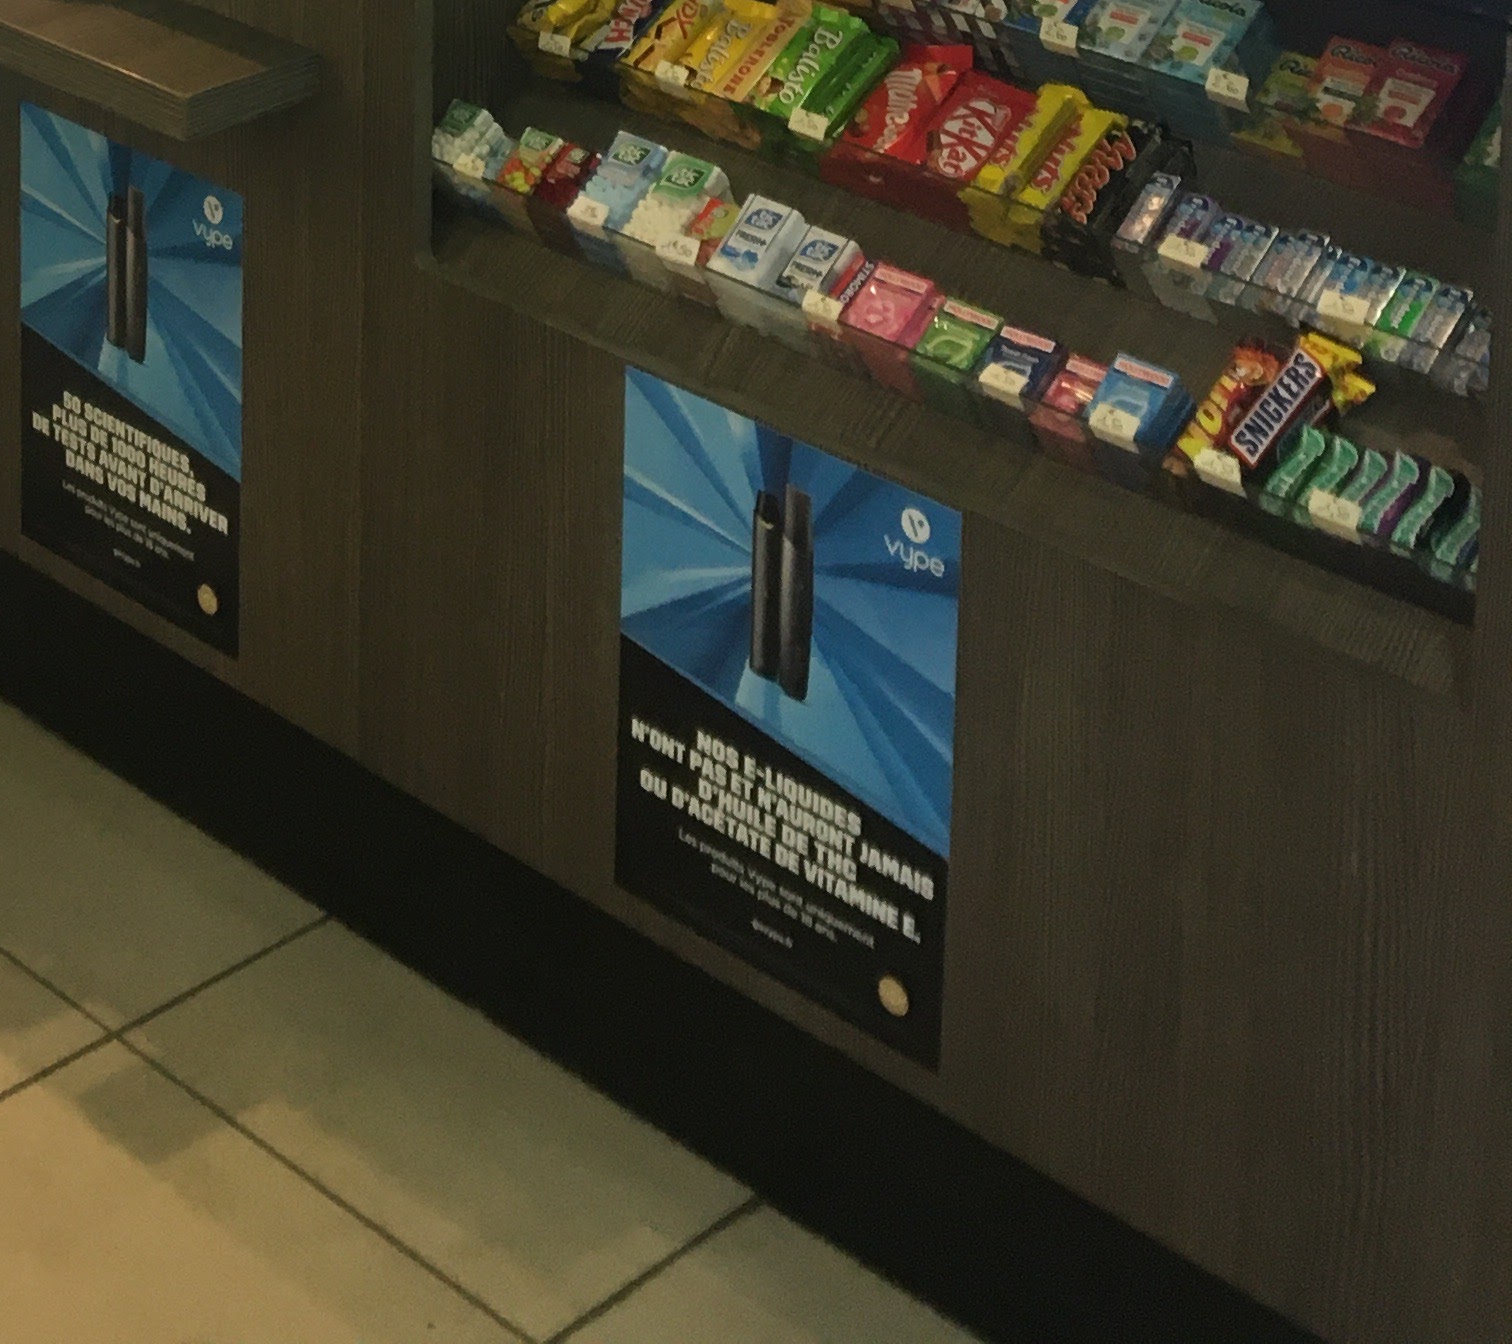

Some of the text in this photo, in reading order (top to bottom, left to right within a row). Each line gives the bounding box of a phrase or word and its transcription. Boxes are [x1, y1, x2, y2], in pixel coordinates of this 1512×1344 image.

[690, 18, 752, 90] Balisto
[722, 16, 798, 97] TOBLERONE
[779, 25, 844, 105] Balisto
[1391, 45, 1461, 75] Ricola
[1030, 112, 1085, 193] Nuts
[192, 217, 235, 251] vype
[63, 390, 195, 479] 50 SCIENTIFIQUES,
[1233, 351, 1319, 457] SNICKERS
[32, 411, 229, 537] DE TESTS AVANT D'ARRIVER
[52, 403, 206, 502] PLUS DE 1000 HEURES
[65, 448, 192, 535] DANS VOS MAINS.
[883, 534, 946, 579] vype
[631, 716, 935, 902] N'ONT PAS ET N'AURONT JAMAIS
[696, 729, 862, 836] NOS E-LIQUIDES
[640, 767, 921, 946] OU D'ACETATE DE VITAMINE E.
[698, 777, 858, 883] D'HUILE DE THC
